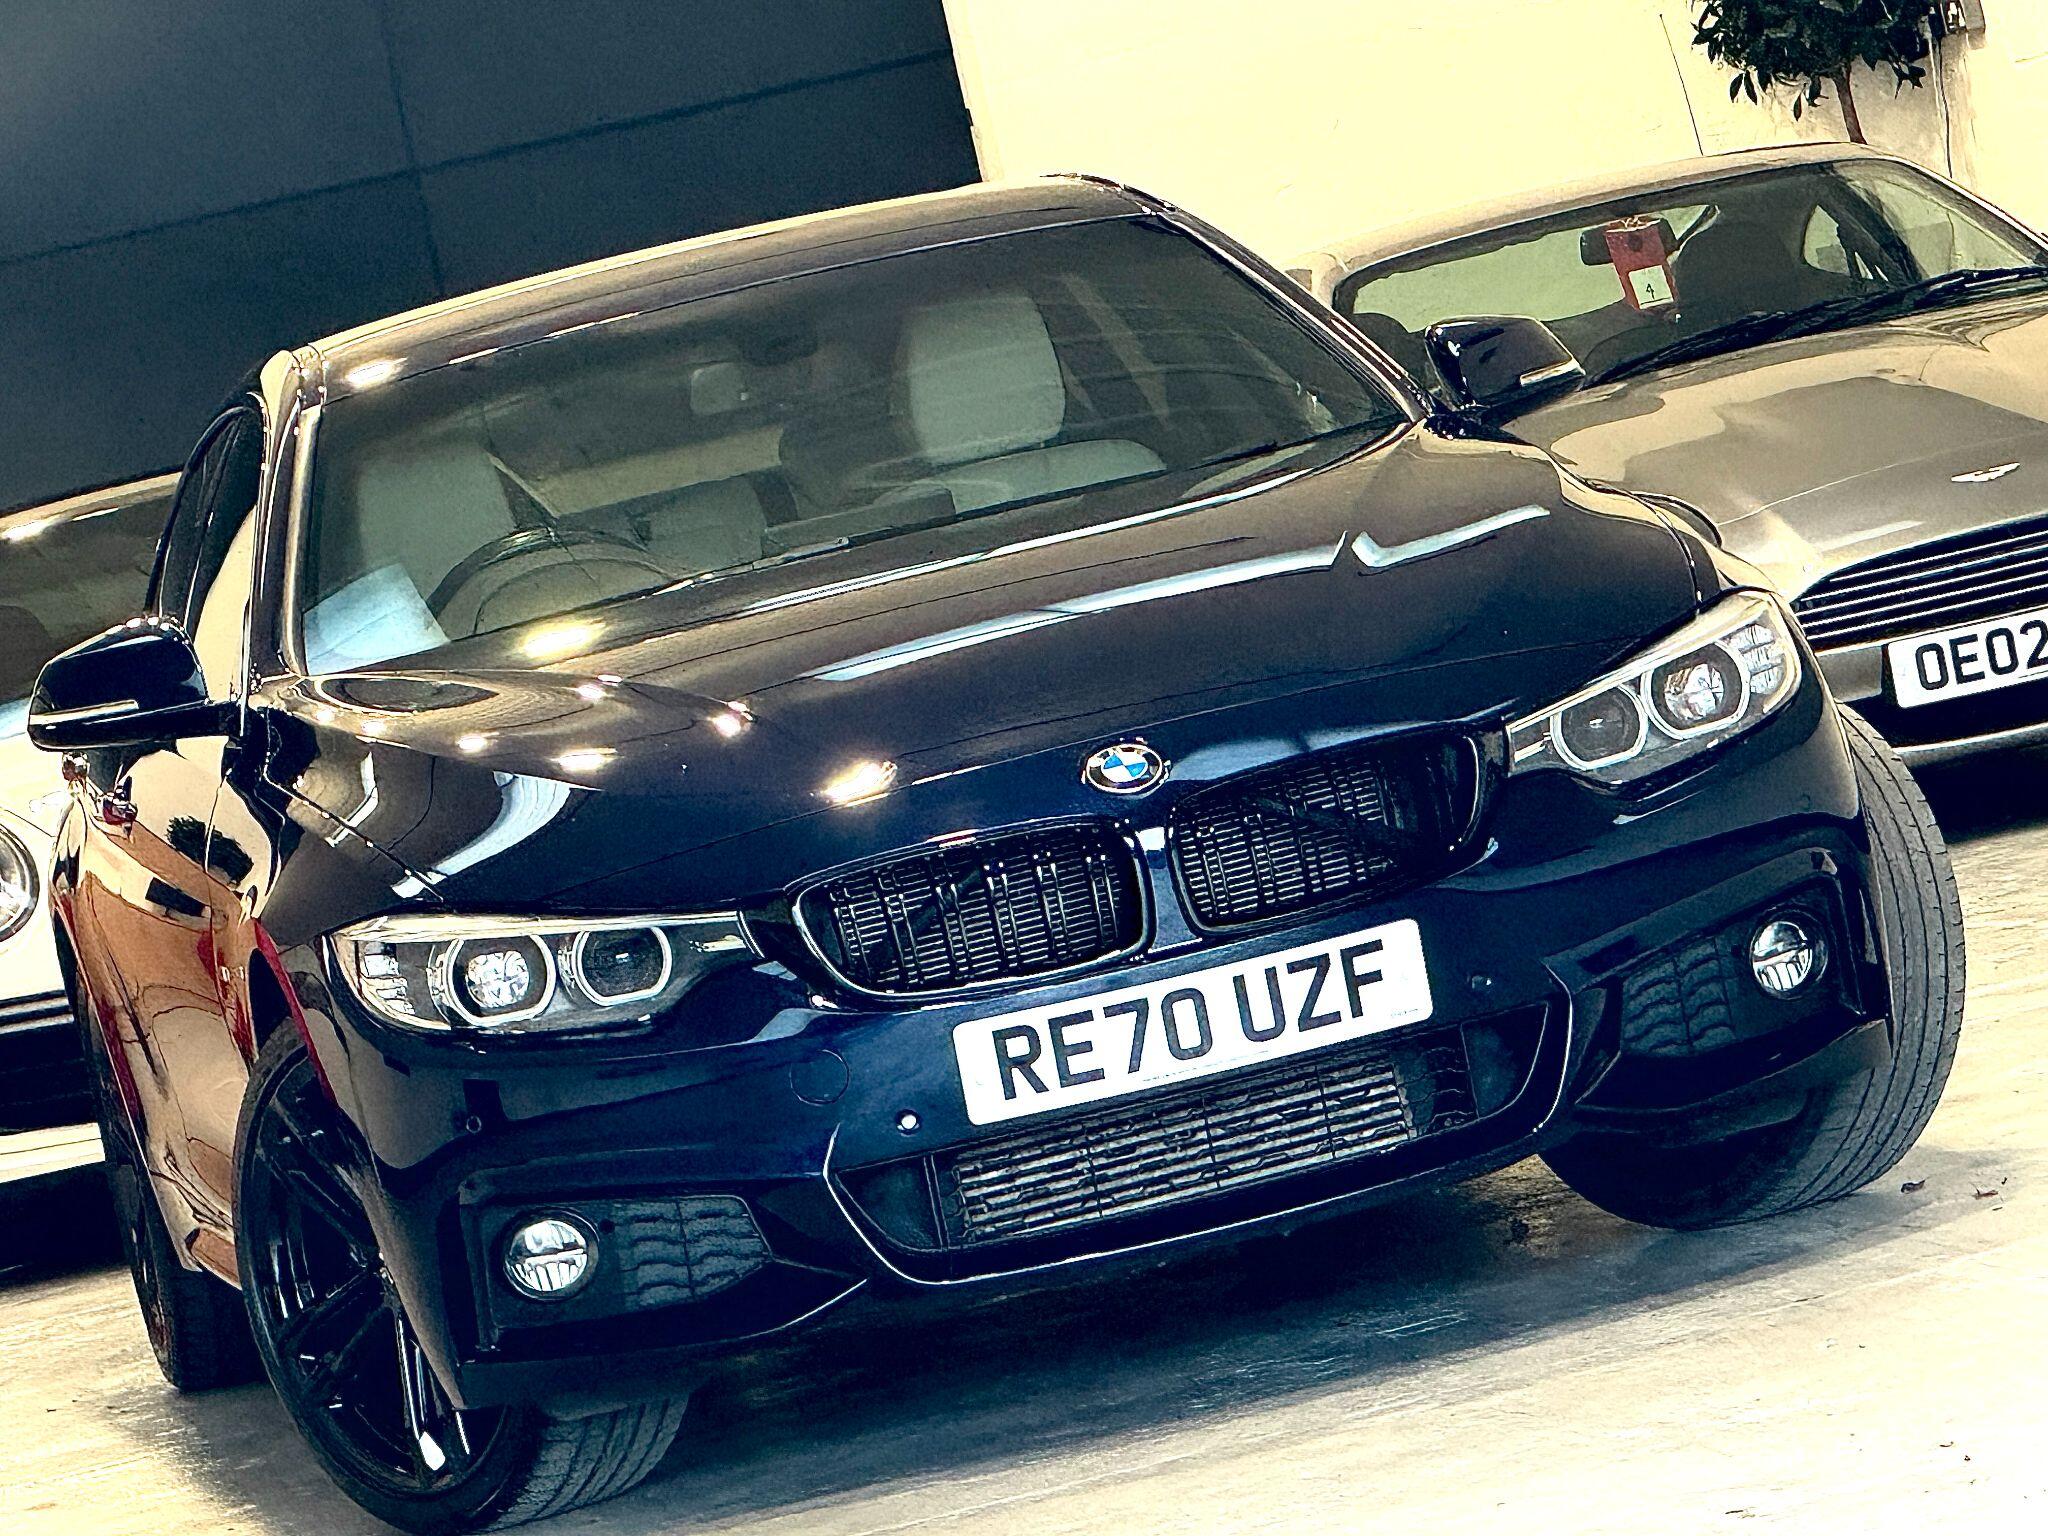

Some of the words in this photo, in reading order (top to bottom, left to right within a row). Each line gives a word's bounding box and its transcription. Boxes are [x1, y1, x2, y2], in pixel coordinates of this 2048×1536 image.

[1915, 619, 2048, 690] OE02
[991, 987, 1214, 1101] RE70
[1232, 939, 1384, 1043] UZF
